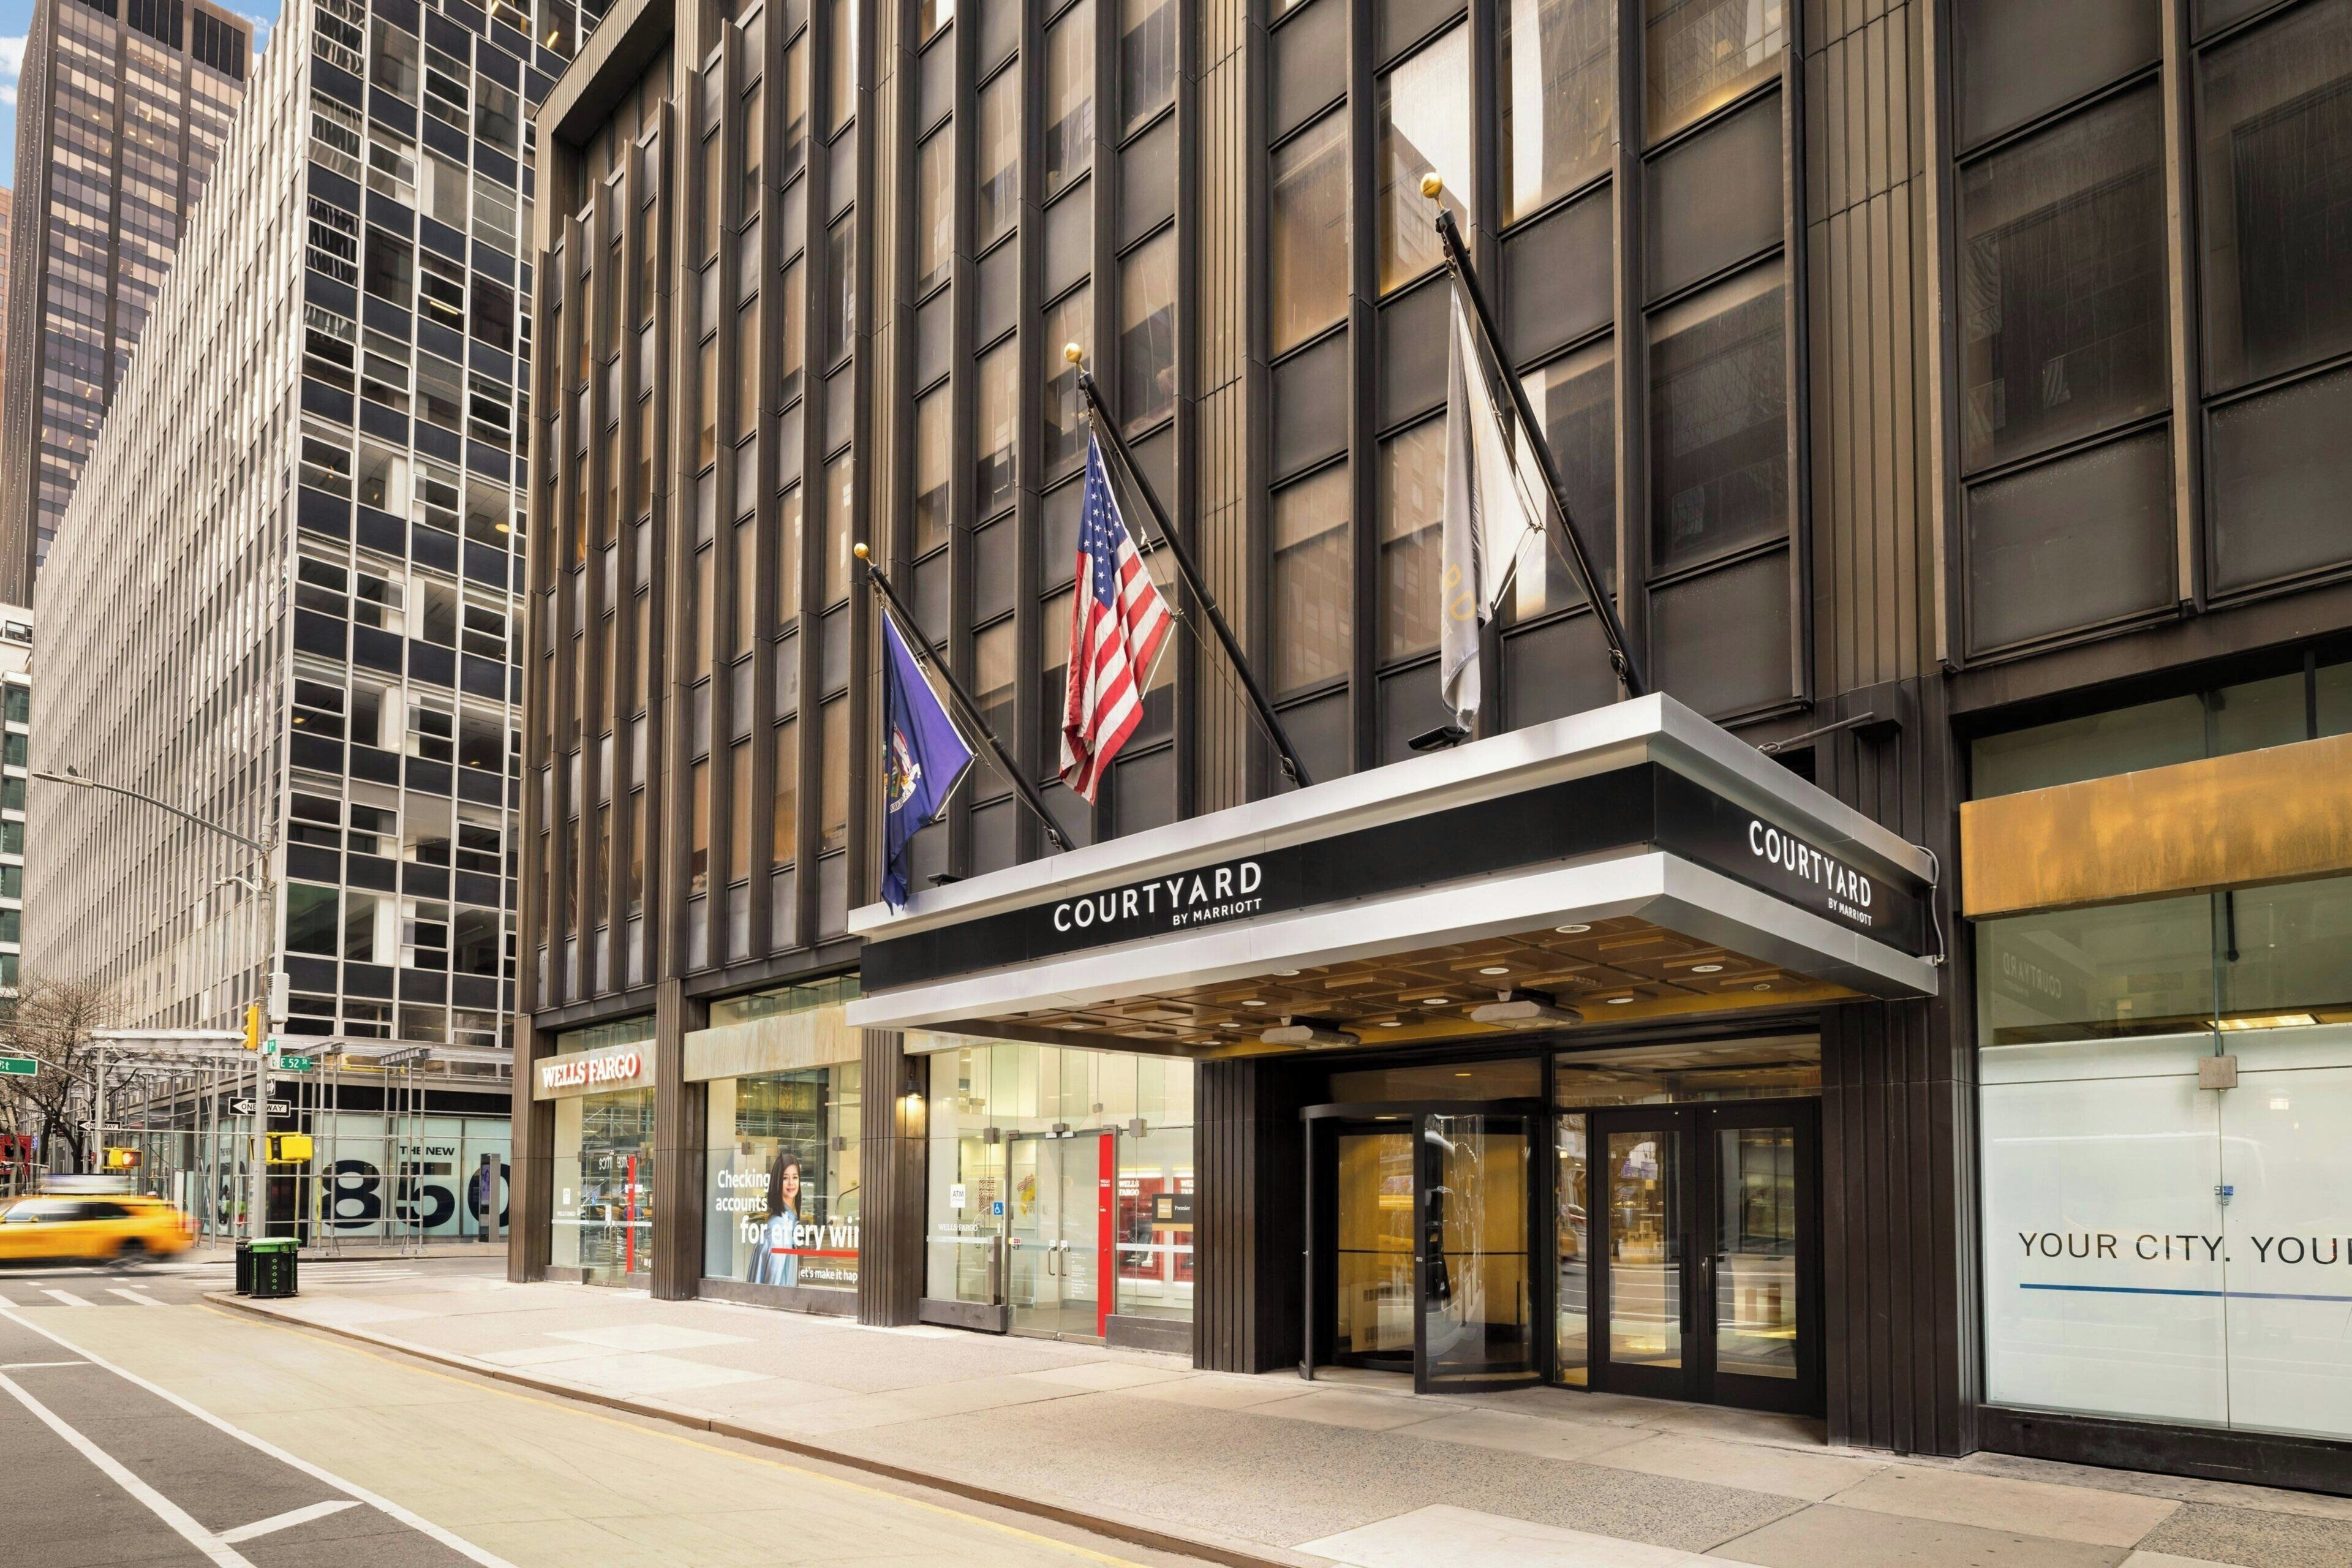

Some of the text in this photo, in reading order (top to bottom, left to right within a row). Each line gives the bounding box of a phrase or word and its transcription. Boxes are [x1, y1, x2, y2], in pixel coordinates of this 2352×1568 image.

[1749, 820, 1871, 907] COURTYARD
[1054, 862, 1262, 932] COURTYARD
[1173, 898, 1262, 925] BY MARRIOTT
[1828, 897, 1872, 926] BY MARRIOTT
[281, 1058, 285, 1068] E
[288, 1058, 300, 1068] 52
[542, 1053, 638, 1088] WELLS FARGO
[399, 1146, 455, 1156] THE NEW
[718, 1169, 771, 1193] Checking
[715, 1196, 768, 1212] accounts
[740, 1215, 768, 1245] for
[2018, 1232, 2117, 1259] YOUR
[2135, 1234, 2231, 1262] CITY.
[799, 1267, 814, 1278] et's
[815, 1268, 835, 1280] make
[836, 1268, 842, 1280] it
